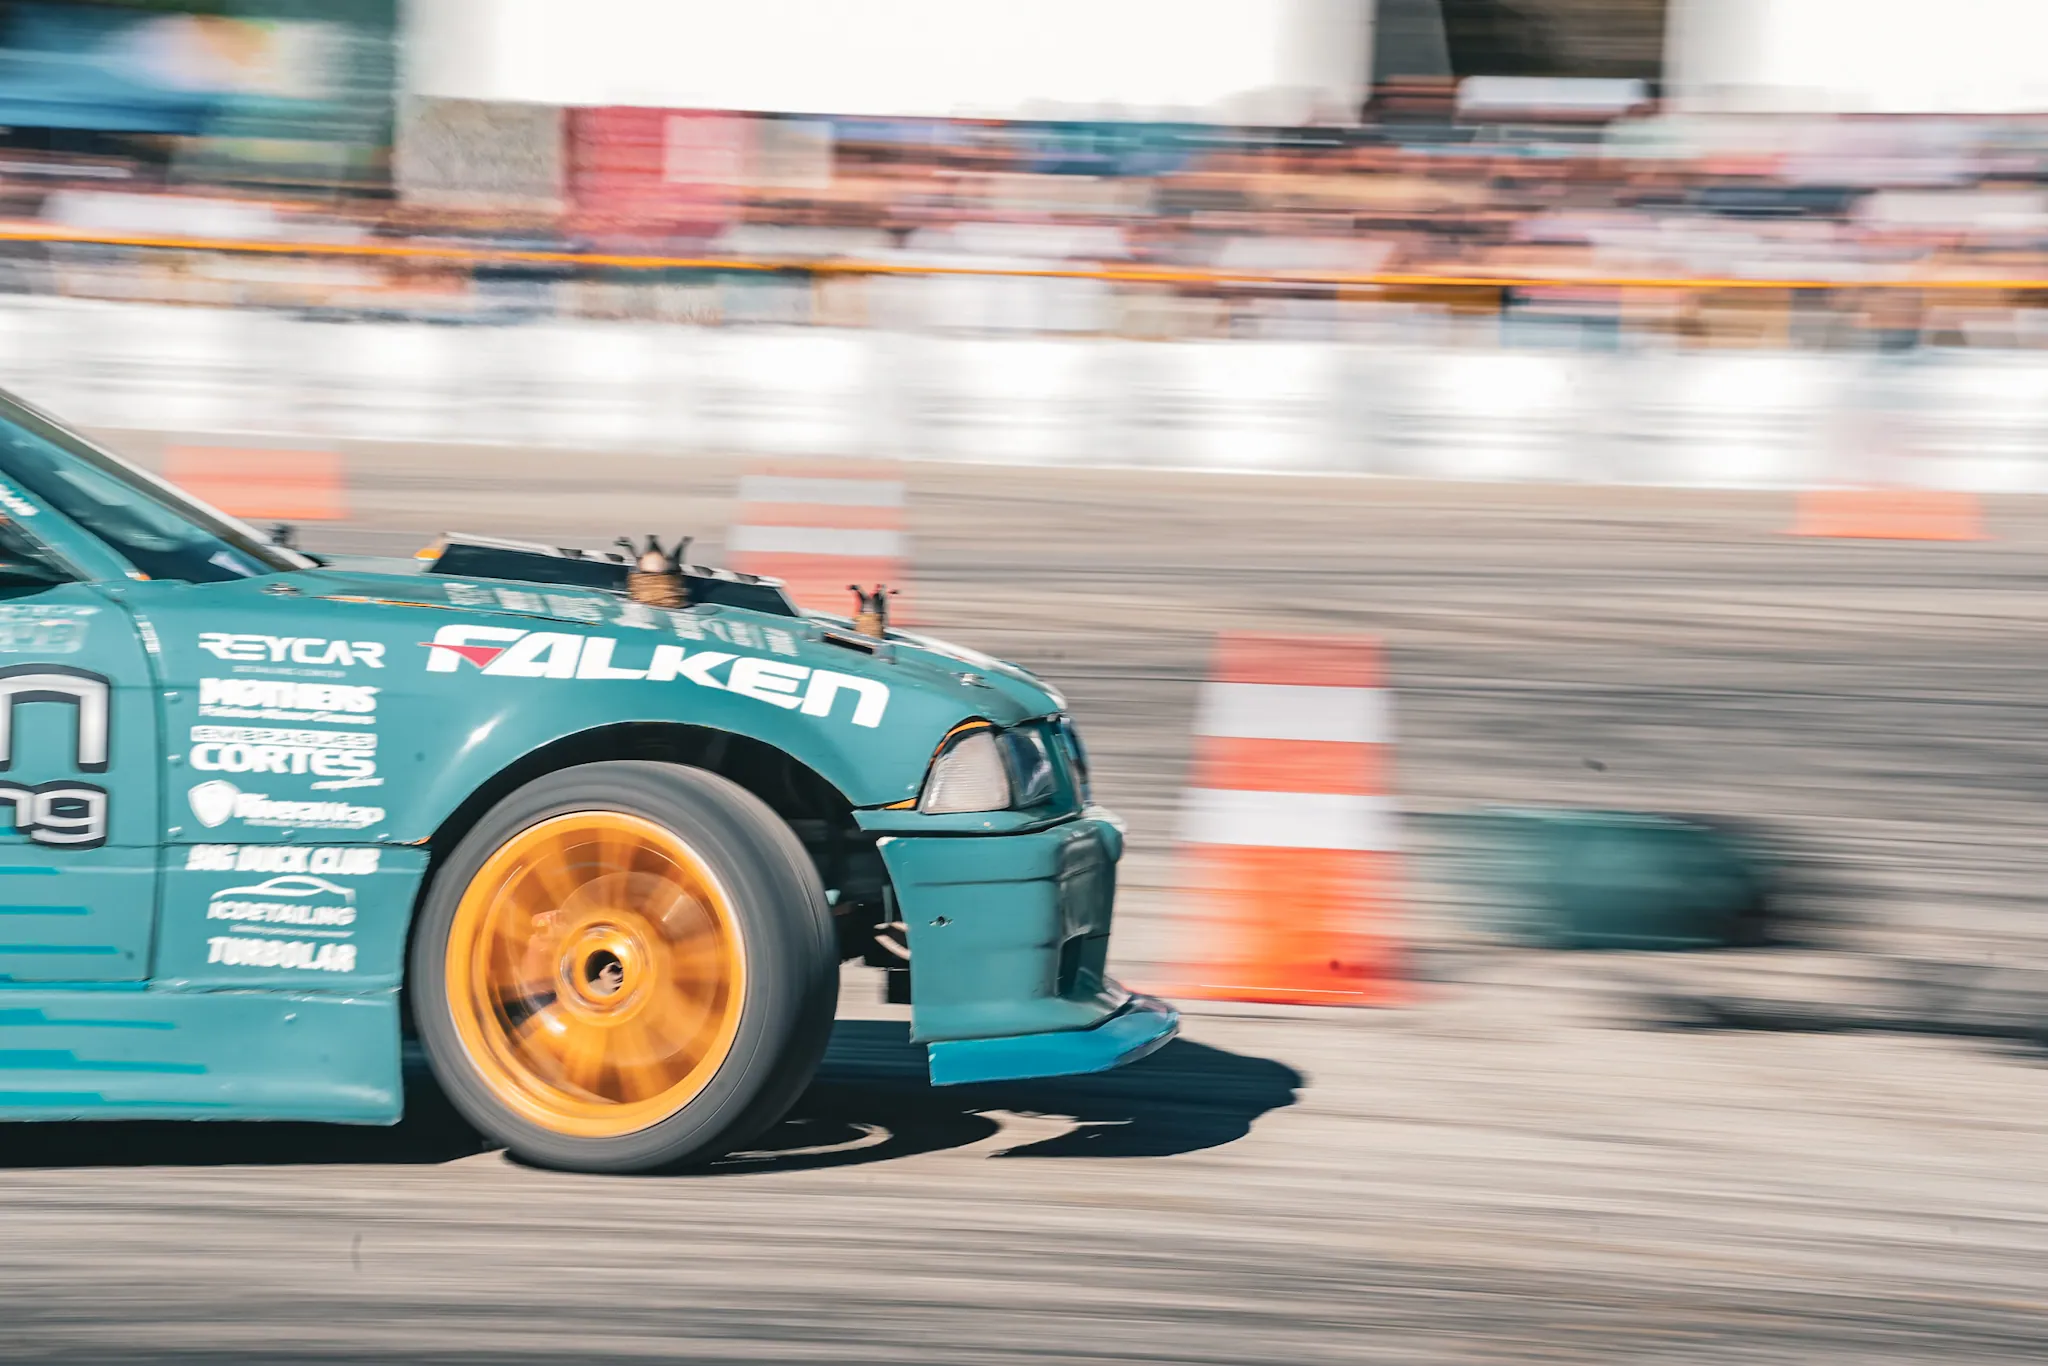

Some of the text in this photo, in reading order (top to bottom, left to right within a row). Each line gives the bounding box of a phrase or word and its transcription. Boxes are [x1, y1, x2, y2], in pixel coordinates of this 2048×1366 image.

[198, 632, 386, 668] REYCAR
[424, 624, 890, 728] FALKEN
[199, 678, 382, 713] MOTHERS
[190, 742, 377, 777] CORTES
[309, 847, 382, 875] CLUB
[206, 936, 358, 973] TURBOLAB
